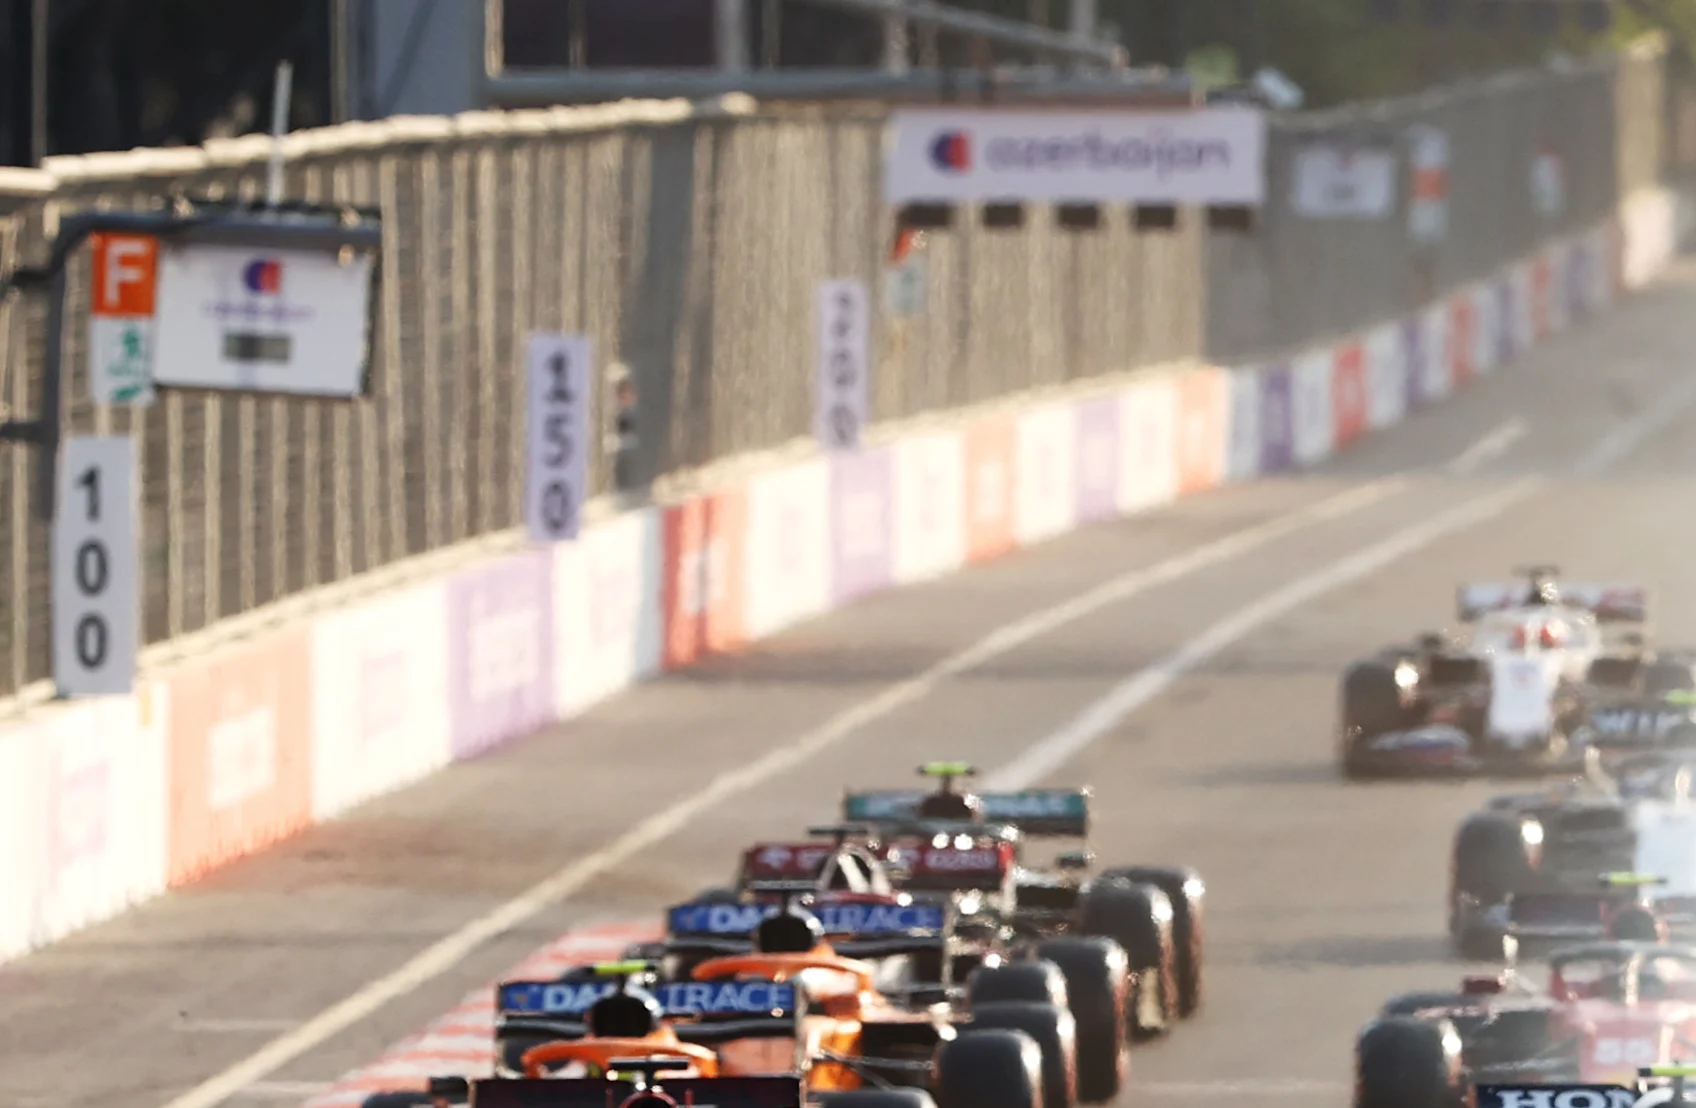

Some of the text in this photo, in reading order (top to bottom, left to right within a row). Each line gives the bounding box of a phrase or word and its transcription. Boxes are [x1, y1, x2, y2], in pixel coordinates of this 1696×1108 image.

[984, 126, 1231, 183] azerbaijan
[103, 240, 148, 307] F
[541, 351, 576, 533] 150
[74, 466, 111, 669] 100
[707, 904, 939, 932] DATRACE
[541, 983, 794, 1013] DATRACE
